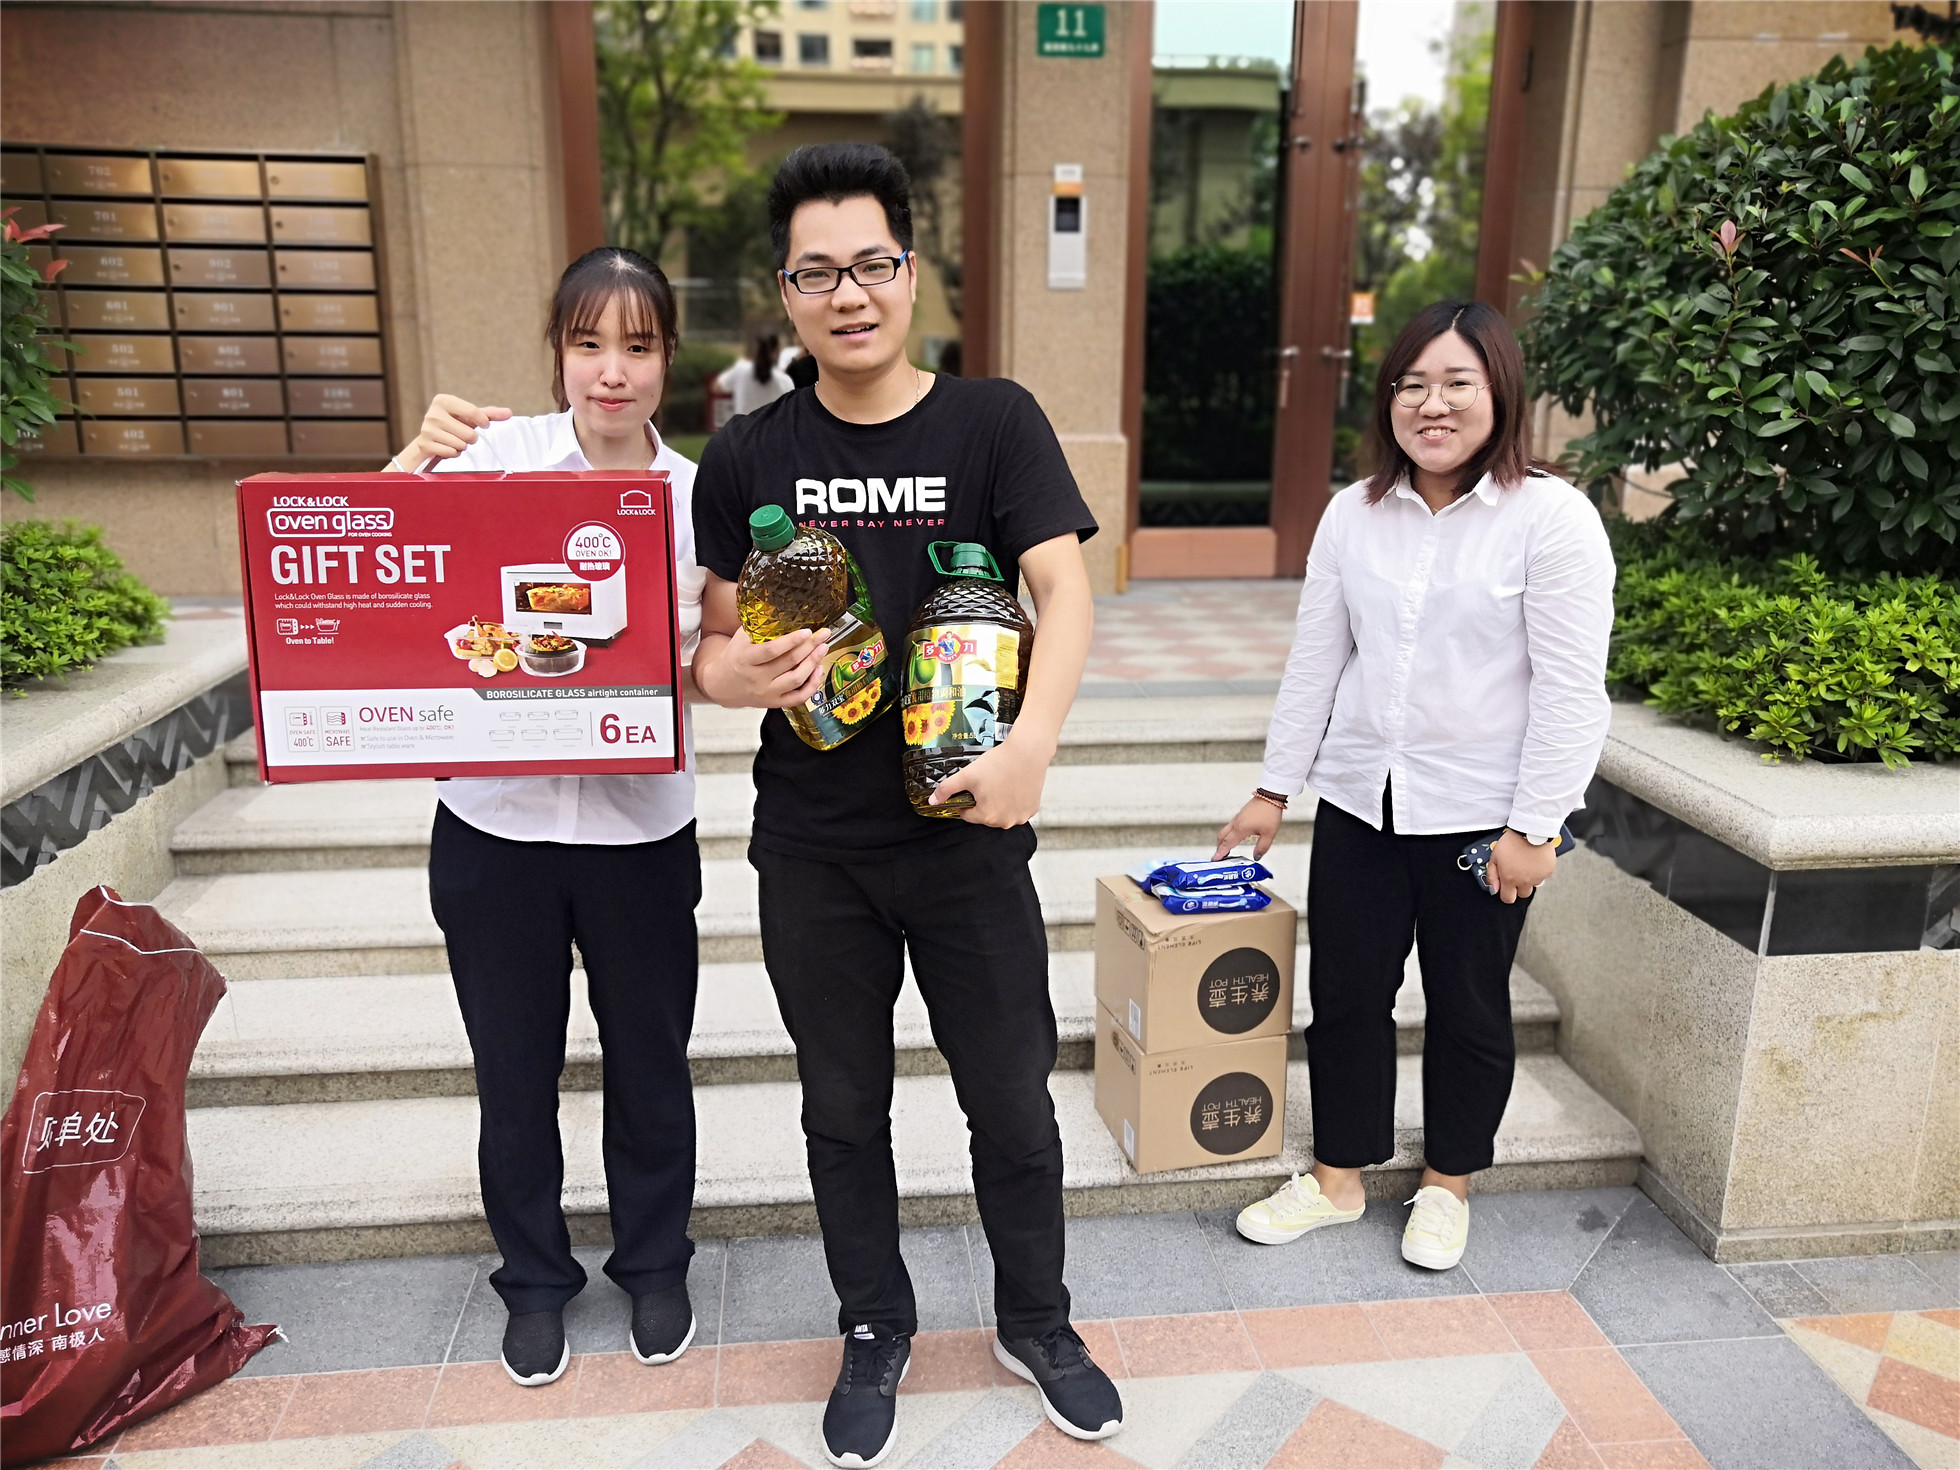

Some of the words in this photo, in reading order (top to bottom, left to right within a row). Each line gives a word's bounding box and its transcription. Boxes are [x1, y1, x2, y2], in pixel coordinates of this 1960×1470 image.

[1055, 8, 1087, 37] 11
[88, 165, 112, 177] 702
[93, 210, 117, 222] 701
[208, 258, 232, 269] 902
[112, 343, 135, 354] 502
[116, 387, 139, 397] 501
[122, 429, 145, 440] 402
[273, 496, 349, 507] LOCK&LOCK
[795, 476, 946, 515] ROME
[275, 514, 328, 531] oven
[332, 510, 389, 535] glass
[798, 519, 849, 528] NEVER
[856, 519, 885, 528] SAY
[893, 518, 945, 527] NEVER
[271, 544, 365, 585] GIFT
[375, 543, 451, 585] SET
[274, 592, 310, 600] Lock&Lock
[310, 592, 327, 600] Oven
[327, 592, 345, 600] Glass
[345, 592, 351, 600] is
[352, 592, 370, 600] made
[370, 591, 377, 600] of
[377, 591, 413, 600] borosilicate
[413, 592, 431, 601] glass
[274, 601, 294, 609] which
[294, 601, 312, 609] could
[312, 601, 343, 609] withstand
[343, 601, 357, 611] high
[358, 601, 372, 609] heat
[372, 601, 385, 609] and
[385, 601, 409, 609] sudden
[409, 601, 433, 610] cooling.
[285, 637, 304, 645] Oven
[304, 637, 312, 645] to
[312, 636, 335, 645] Table!
[486, 689, 554, 699] BOROSILICATE
[555, 688, 586, 698] GLASS
[587, 688, 618, 698] airtight
[619, 687, 659, 697] container
[358, 706, 414, 723] OVEN
[418, 704, 455, 723] safe
[325, 735, 351, 747] SAFE
[1209, 978, 1228, 989] POT
[1233, 973, 1269, 985] HEALTH
[1209, 982, 1269, 1008] 养生壶
[1202, 1102, 1221, 1112] POT
[1225, 1096, 1262, 1108] HEALTH
[1202, 1105, 1262, 1131] 养生壶
[55, 1302, 112, 1328] Love
[51, 1327, 106, 1352] 南极人
